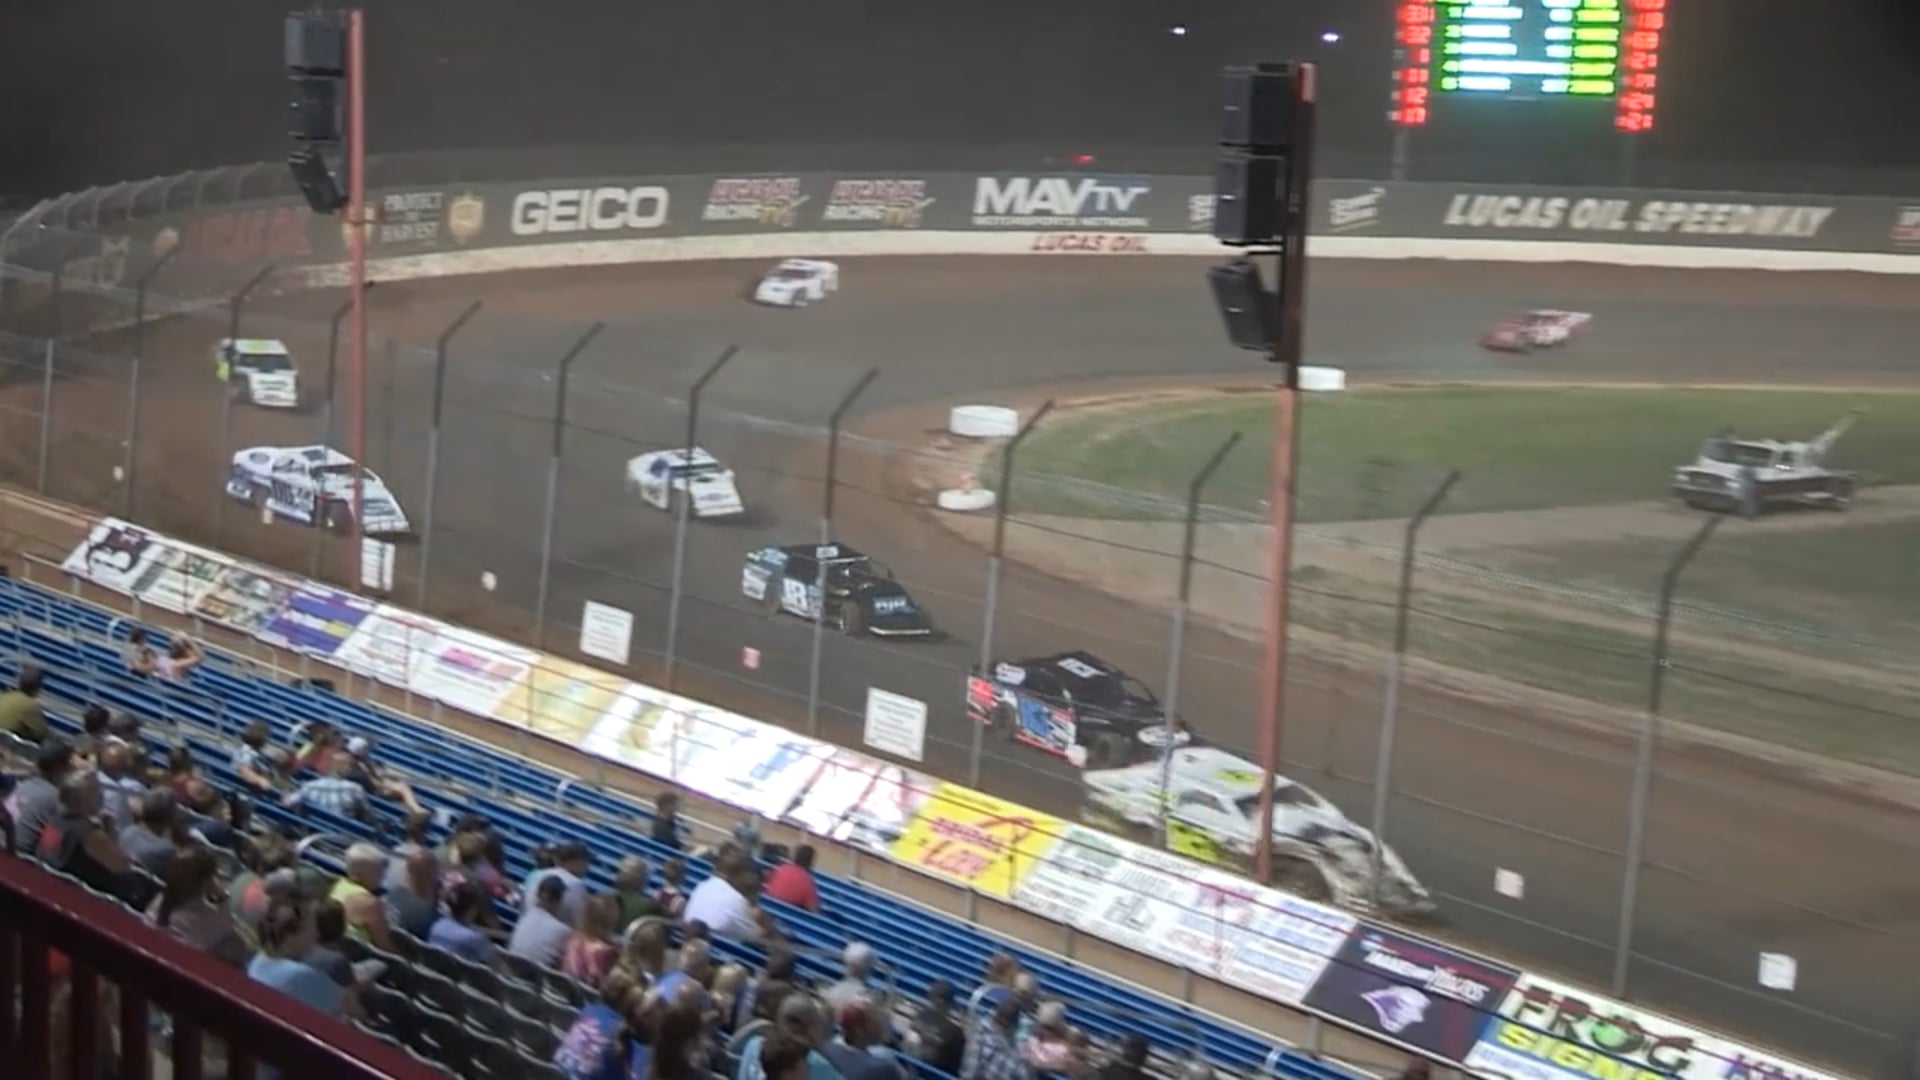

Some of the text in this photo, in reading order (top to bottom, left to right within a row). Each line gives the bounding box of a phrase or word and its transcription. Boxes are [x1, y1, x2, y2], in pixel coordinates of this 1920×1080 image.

[511, 185, 669, 235] GEICO
[1443, 194, 1834, 238] LUCAS OIL SPEEDWAY
[1031, 233, 1149, 251] LUCAS OIL
[1497, 1019, 1670, 1080] SIGN
[1510, 984, 1694, 1073] FROG
